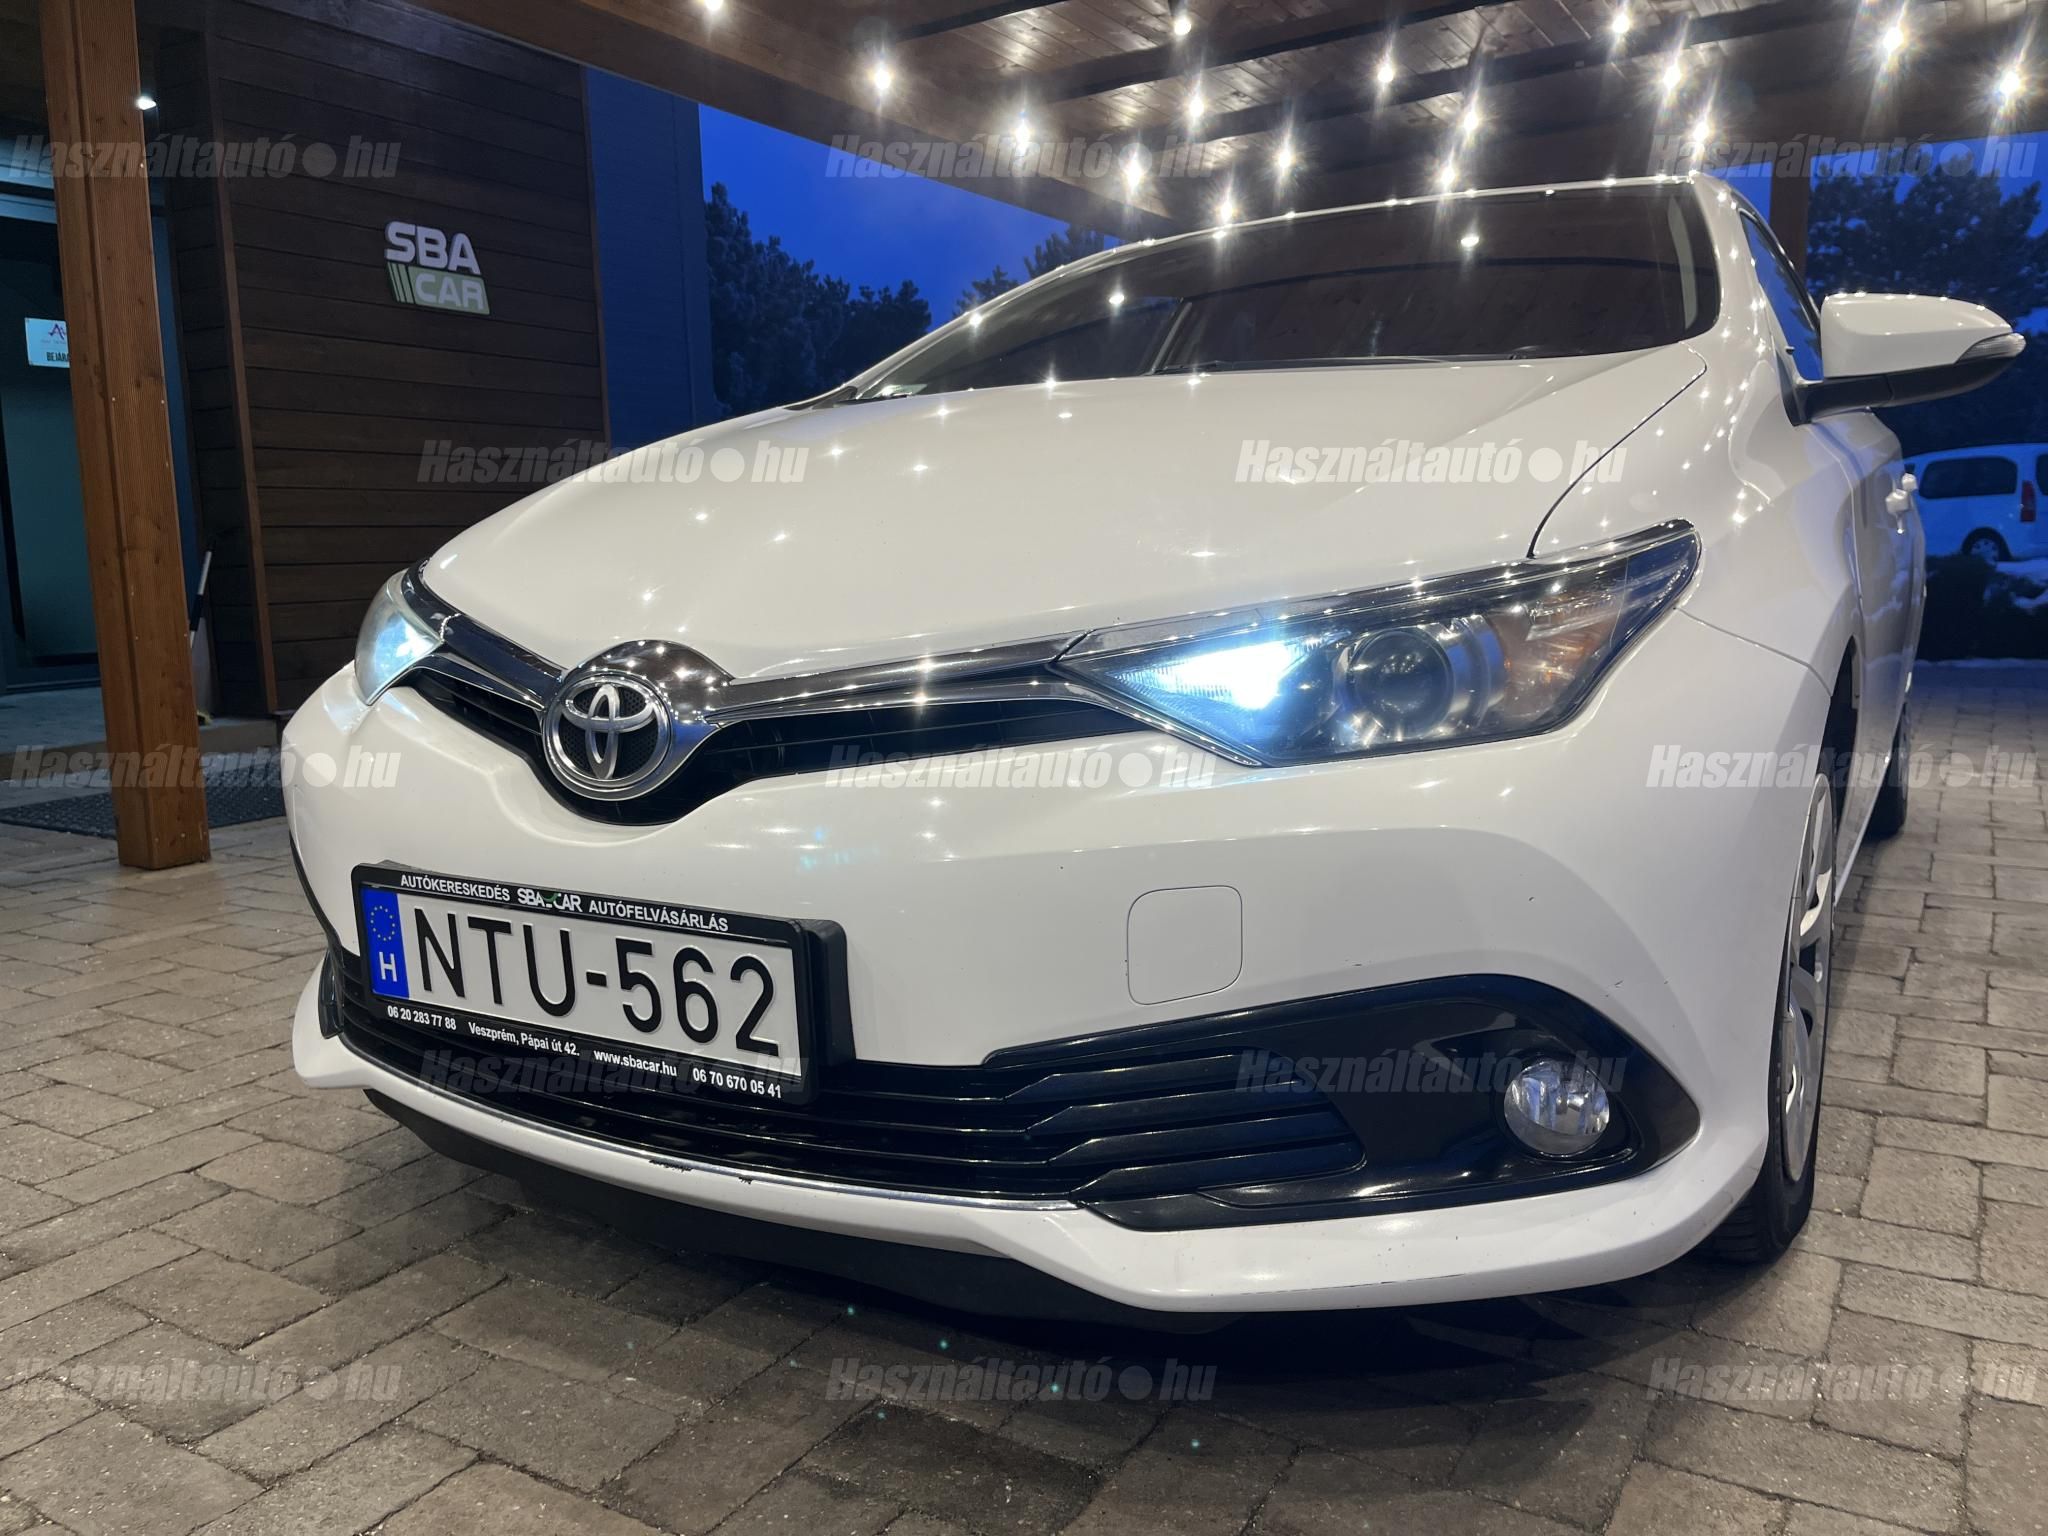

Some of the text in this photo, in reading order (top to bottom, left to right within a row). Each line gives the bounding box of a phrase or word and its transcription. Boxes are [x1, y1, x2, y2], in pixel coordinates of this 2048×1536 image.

[385, 221, 481, 275] SBA
[416, 273, 484, 310] CAR
[400, 874, 510, 901] AUTÓKERESKEDÉS
[588, 899, 728, 932] AUTÓFELVÁSÁRLÁS
[379, 951, 397, 983] H
[414, 906, 780, 1057] NTU-562
[387, 1005, 782, 1099] 06 20 283 77 88 Veszprém, Pápai út 42. www.sbacar.hu 06 70 670 05 41
